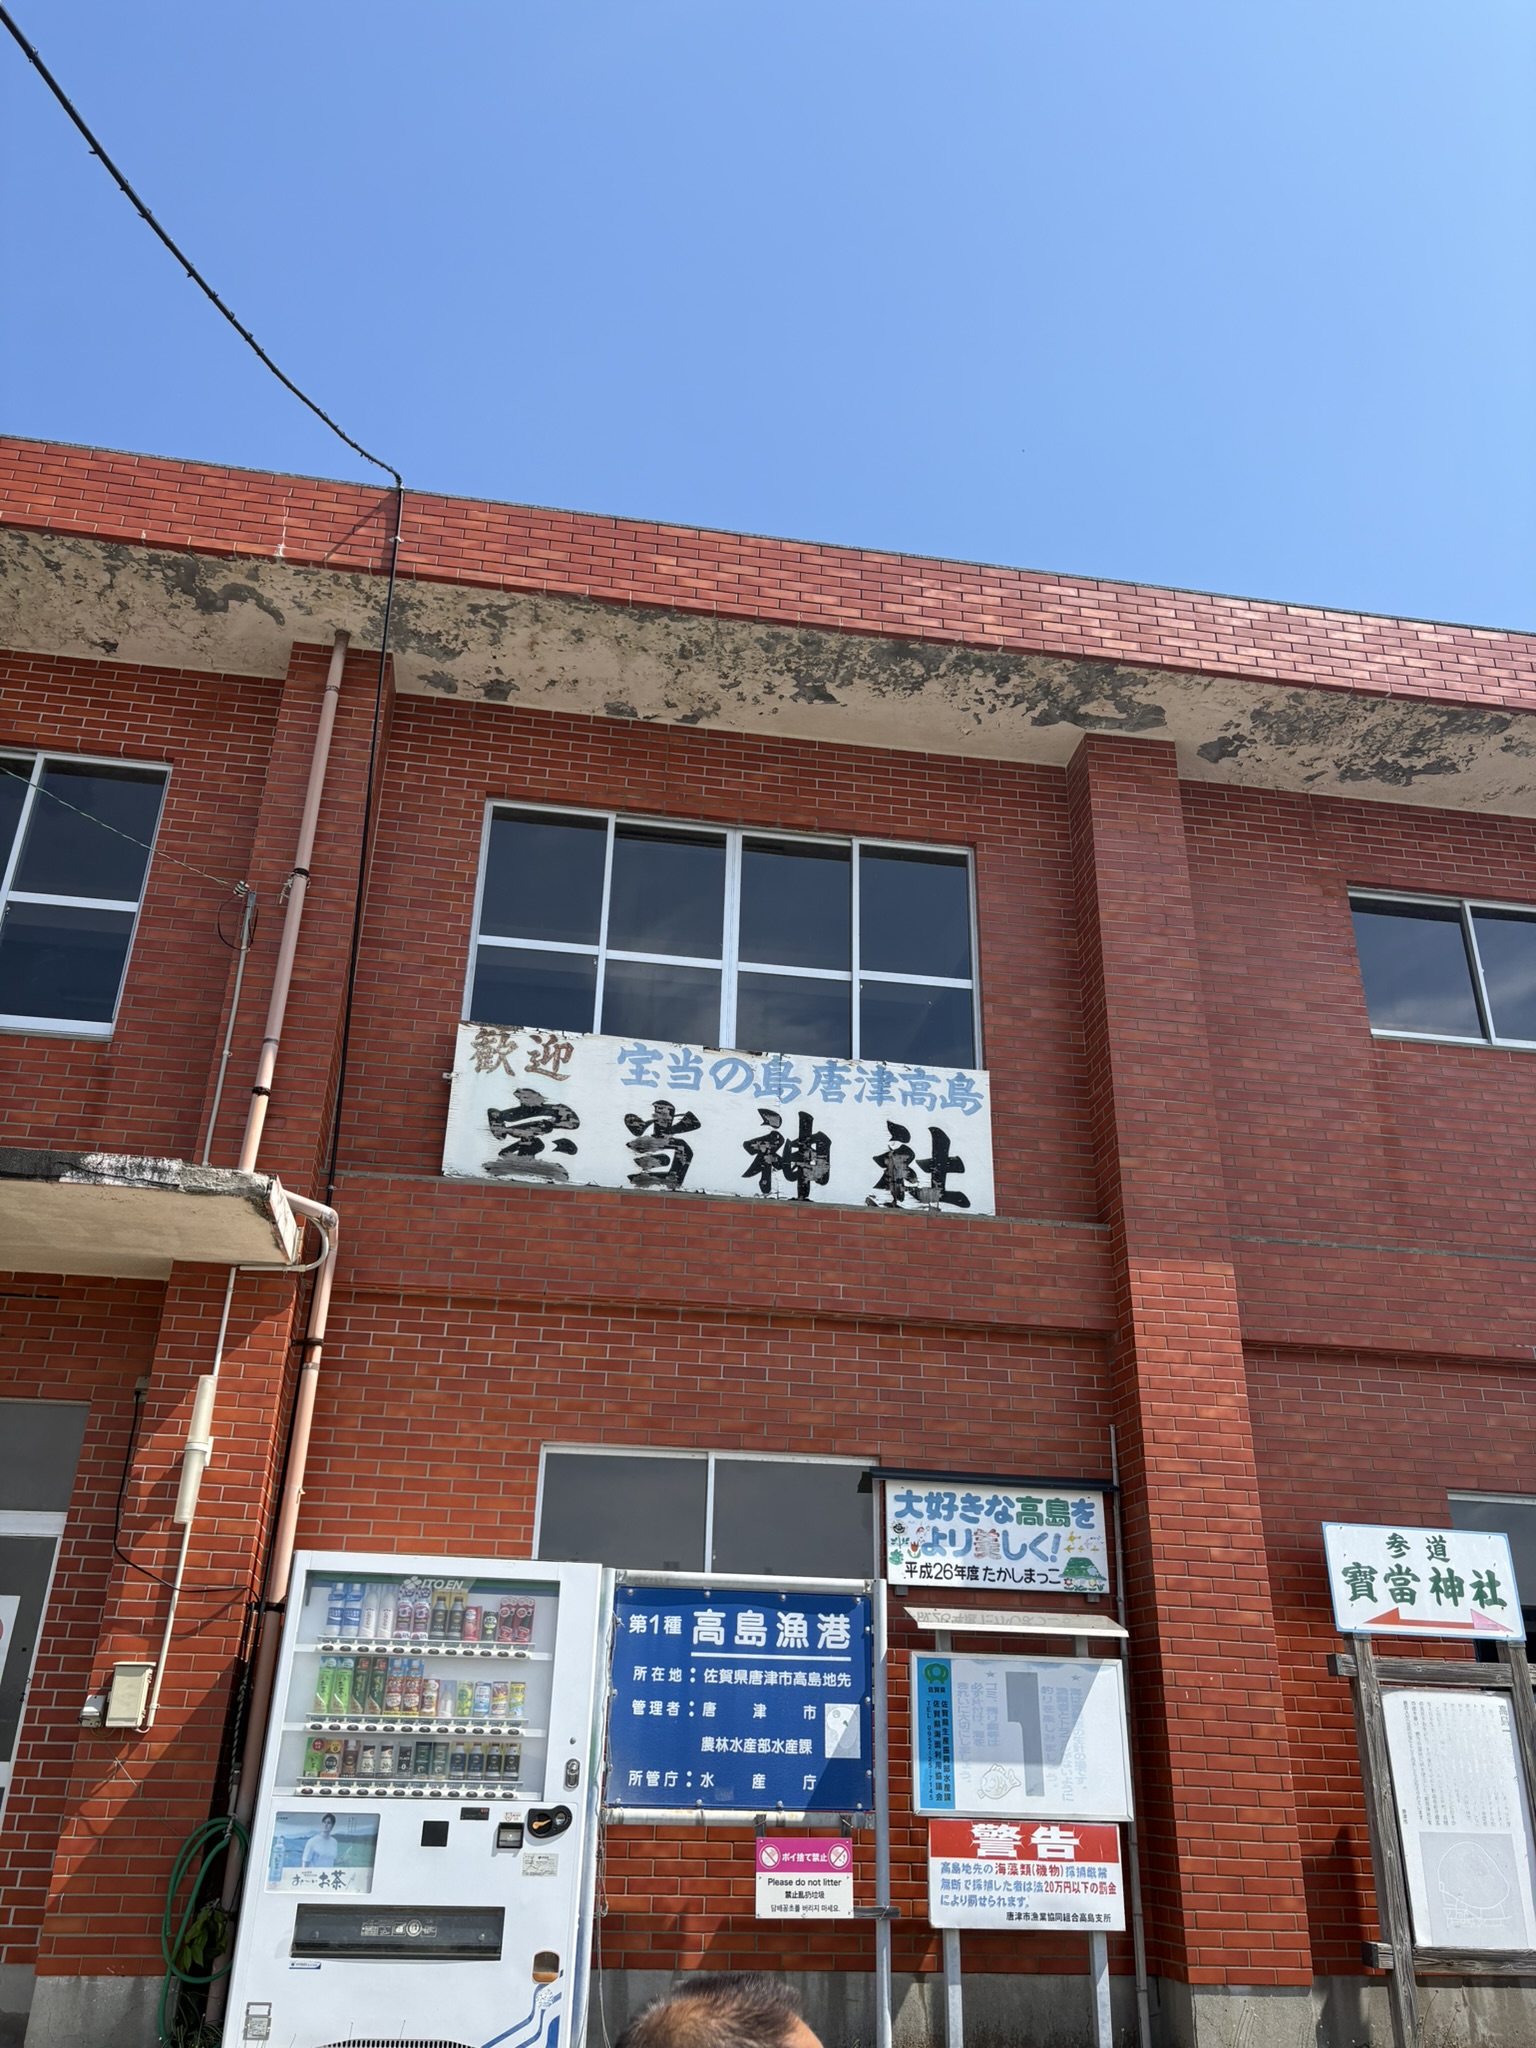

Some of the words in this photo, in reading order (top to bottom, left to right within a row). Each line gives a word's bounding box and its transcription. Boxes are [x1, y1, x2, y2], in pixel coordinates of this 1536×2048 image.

[469, 1027, 574, 1081] 歓迎
[617, 1041, 984, 1116] 宝当の島唐津高島
[482, 1087, 971, 1210] 宝当神社
[893, 1489, 1096, 1530] 大好きな高島を
[1384, 1532, 1452, 1563] 参道
[421, 1579, 444, 1589] ITO
[444, 1580, 464, 1589] EN
[904, 1561, 980, 1582] 平成26年度
[982, 1564, 1062, 1585] たかしまっこ
[1341, 1562, 1508, 1609] 寶當神社
[628, 1613, 682, 1636] 第1種
[692, 1608, 852, 1650] 高島漁港
[703, 1668, 852, 1688] 佐賀県唐津市高島地先
[700, 1736, 813, 1755] 農林水産部水産課
[970, 1823, 1081, 1860] 警告
[782, 1852, 829, 1863] ポイ捨て禁止
[767, 1878, 794, 1887] Please
[795, 1878, 806, 1887] do
[807, 1878, 822, 1887] not
[823, 1878, 842, 1887] litter
[802, 1904, 820, 1913] 버리지
[1006, 1911, 1112, 1924] 唐津市漁業協同組合高島支所
